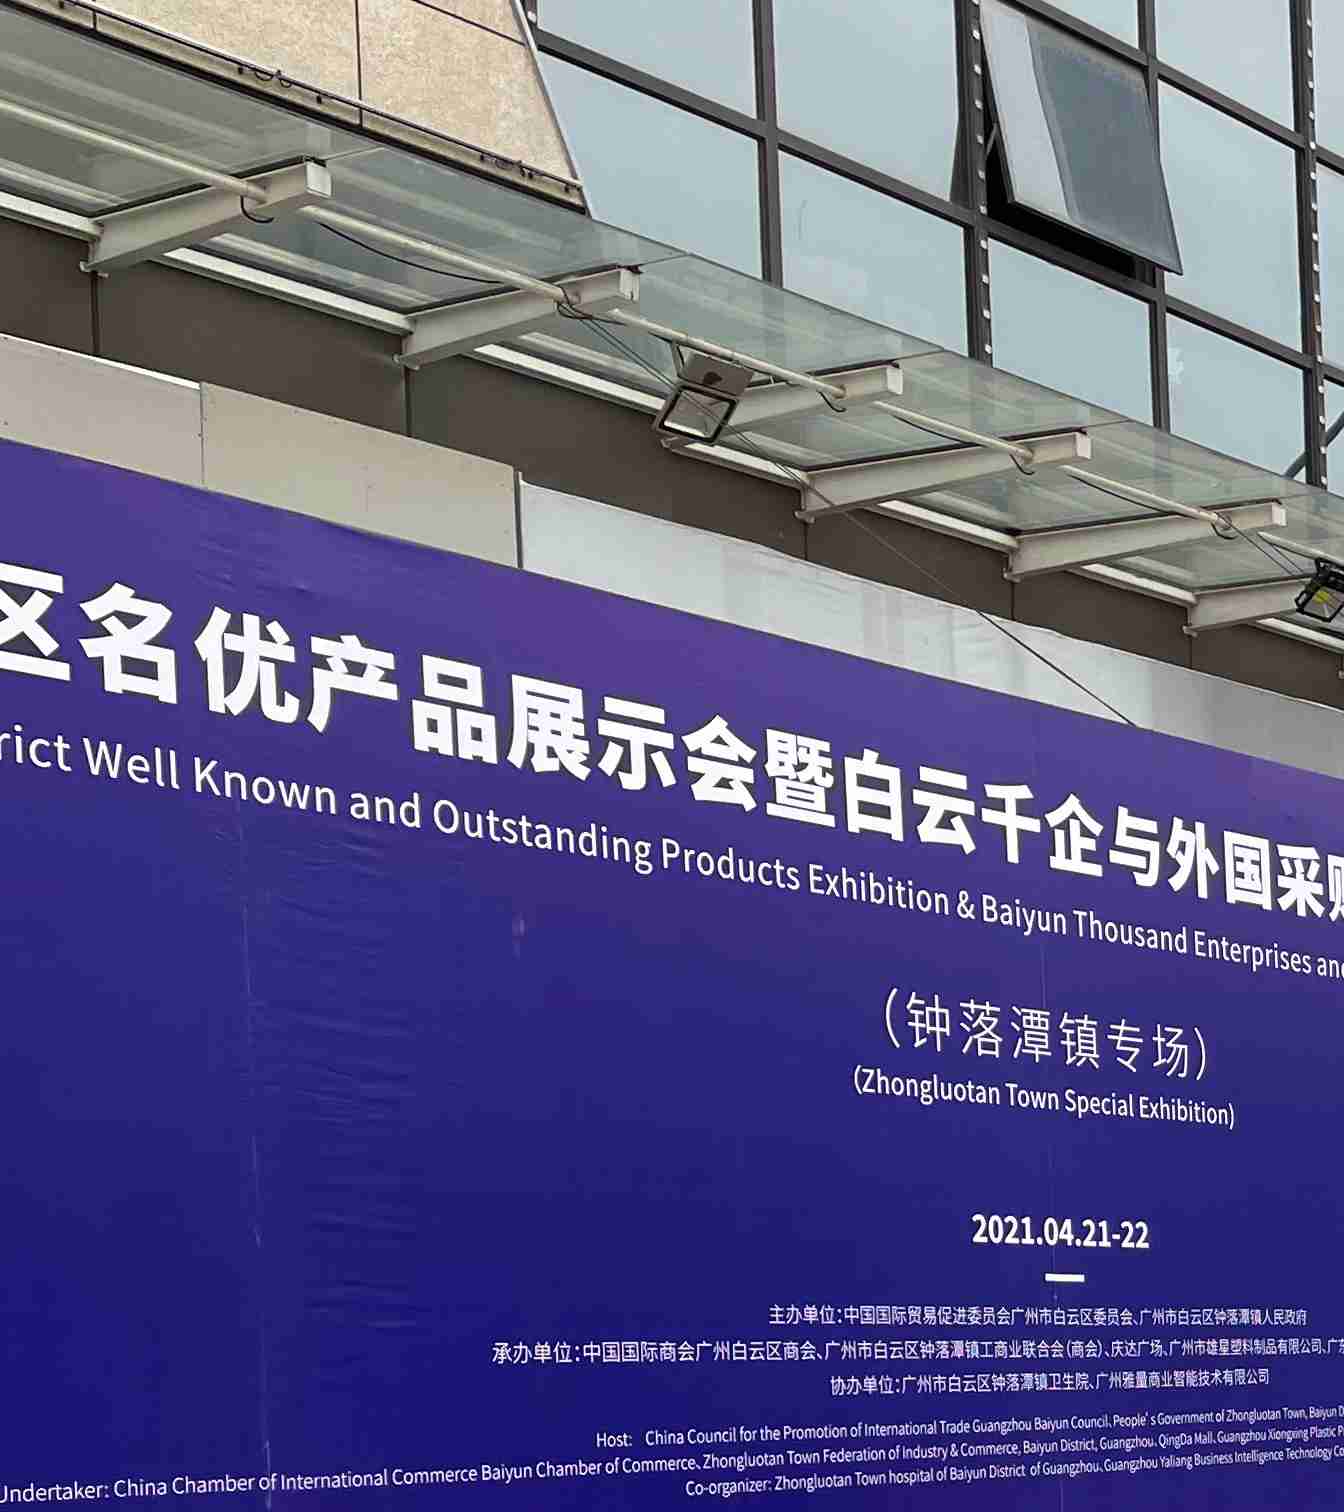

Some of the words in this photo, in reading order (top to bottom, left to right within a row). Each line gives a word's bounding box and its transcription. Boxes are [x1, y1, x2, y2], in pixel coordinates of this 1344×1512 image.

[82, 737, 180, 790] Well
[194, 756, 336, 815] Known
[350, 792, 421, 829] and
[433, 799, 653, 875] Outstanding
[662, 838, 801, 890] Products
[809, 863, 949, 916] Exhibition
[956, 890, 976, 920] &
[982, 894, 1067, 936] Baiyun
[1072, 909, 1187, 954] Thousand
[1194, 930, 1312, 974] Enterprises
[854, 1064, 1000, 1106] (Zhongluotan
[1004, 1082, 1060, 1110] Town
[1064, 1088, 1135, 1119] Special
[1139, 1096, 1235, 1130] Exhibition)
[971, 1213, 1150, 1249] 2021.04.21-22
[596, 1432, 633, 1448] Host:
[645, 1429, 685, 1446] China
[687, 1426, 737, 1445] Council
[739, 1425, 758, 1442] for
[759, 1425, 781, 1441] the
[783, 1424, 848, 1440] Promotion
[849, 1421, 863, 1438] of
[864, 1420, 937, 1437] International
[939, 1419, 971, 1434] Trade
[972, 1417, 1032, 1436] Guangzhou
[1034, 1416, 1070, 1433] Baiyun
[1156, 1411, 1215, 1426] Government
[1215, 1408, 1225, 1423] of
[1225, 1407, 1282, 1425] Zhongluotan
[1281, 1407, 1308, 1420] Town,
[1309, 1406, 1338, 1421] Baiyun
[113, 1478, 168, 1498] China
[172, 1473, 256, 1495] Chamber
[258, 1472, 278, 1491] of
[280, 1468, 388, 1490] International
[391, 1468, 479, 1486] Commerce
[481, 1463, 533, 1484] Baiyun
[535, 1459, 603, 1478] Chamber
[605, 1456, 620, 1475] of
[702, 1451, 785, 1472] Zhongluotan
[786, 1450, 821, 1465] Town
[823, 1446, 886, 1463] Federation
[887, 1444, 901, 1461] of
[902, 1445, 949, 1462] Industry
[949, 1443, 959, 1458] &
[960, 1442, 1022, 1457] Commerce,
[1023, 1440, 1059, 1457] Baiyun
[1060, 1438, 1098, 1453] District,
[1158, 1432, 1193, 1450] QingDa
[1216, 1429, 1267, 1446] Guangzhou
[1309, 1425, 1337, 1439] Plastic
